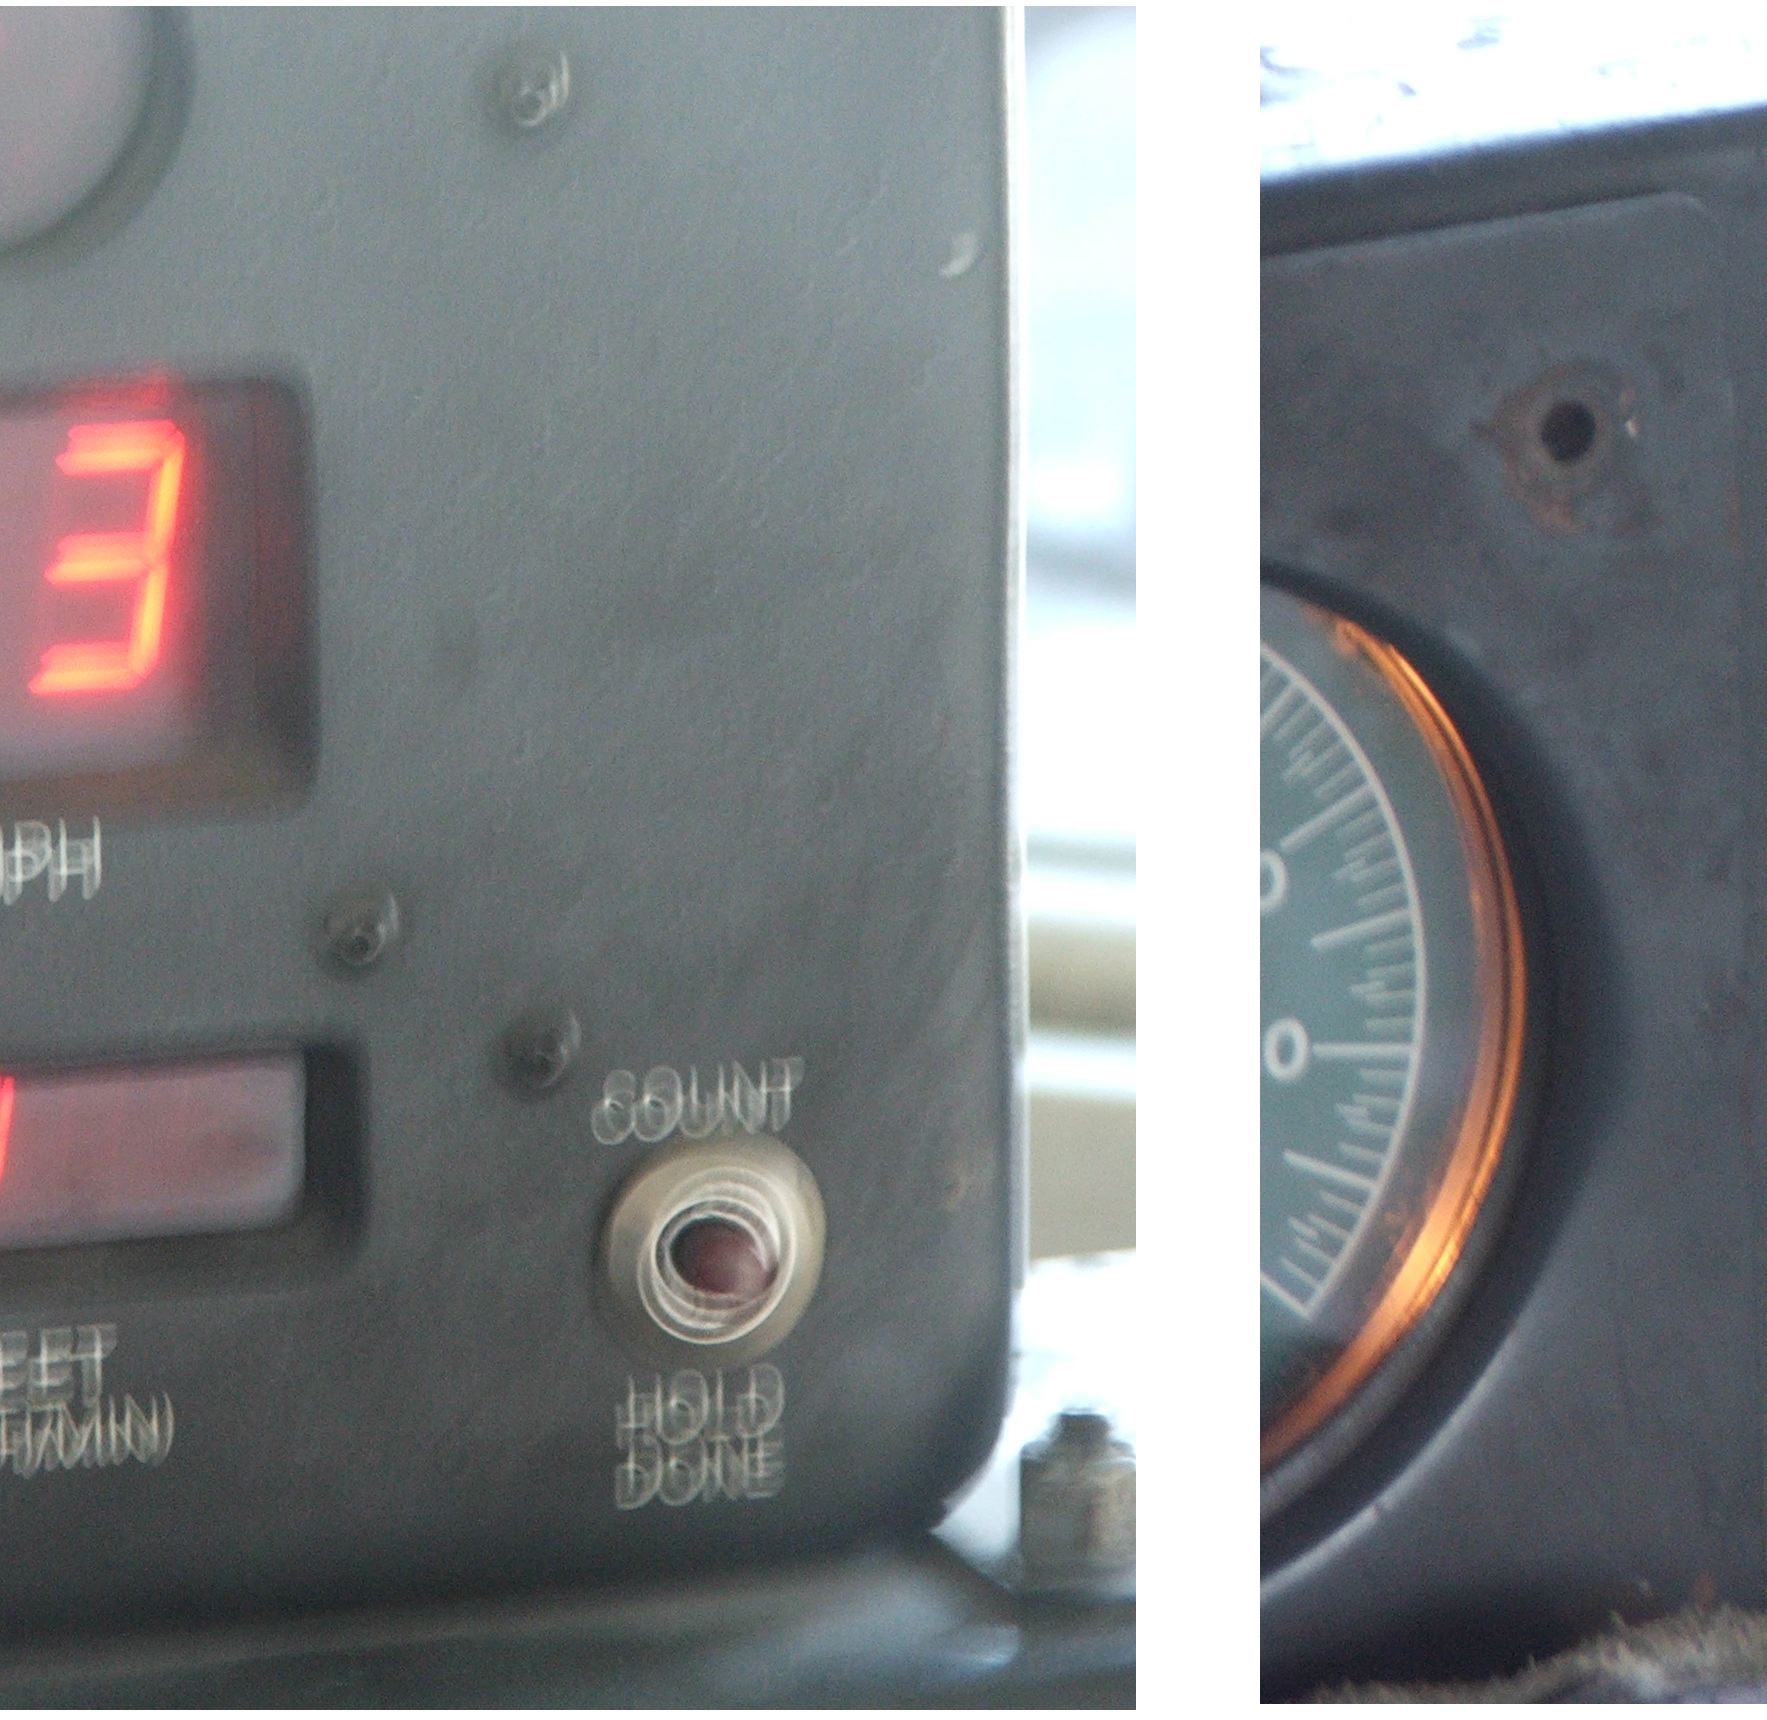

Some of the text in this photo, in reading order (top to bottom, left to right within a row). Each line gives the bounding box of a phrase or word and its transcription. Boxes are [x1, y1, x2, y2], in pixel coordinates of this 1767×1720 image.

[590, 1055, 806, 1145] COUNT
[616, 1363, 785, 1450] HOLD
[616, 1434, 785, 1511] DONE
